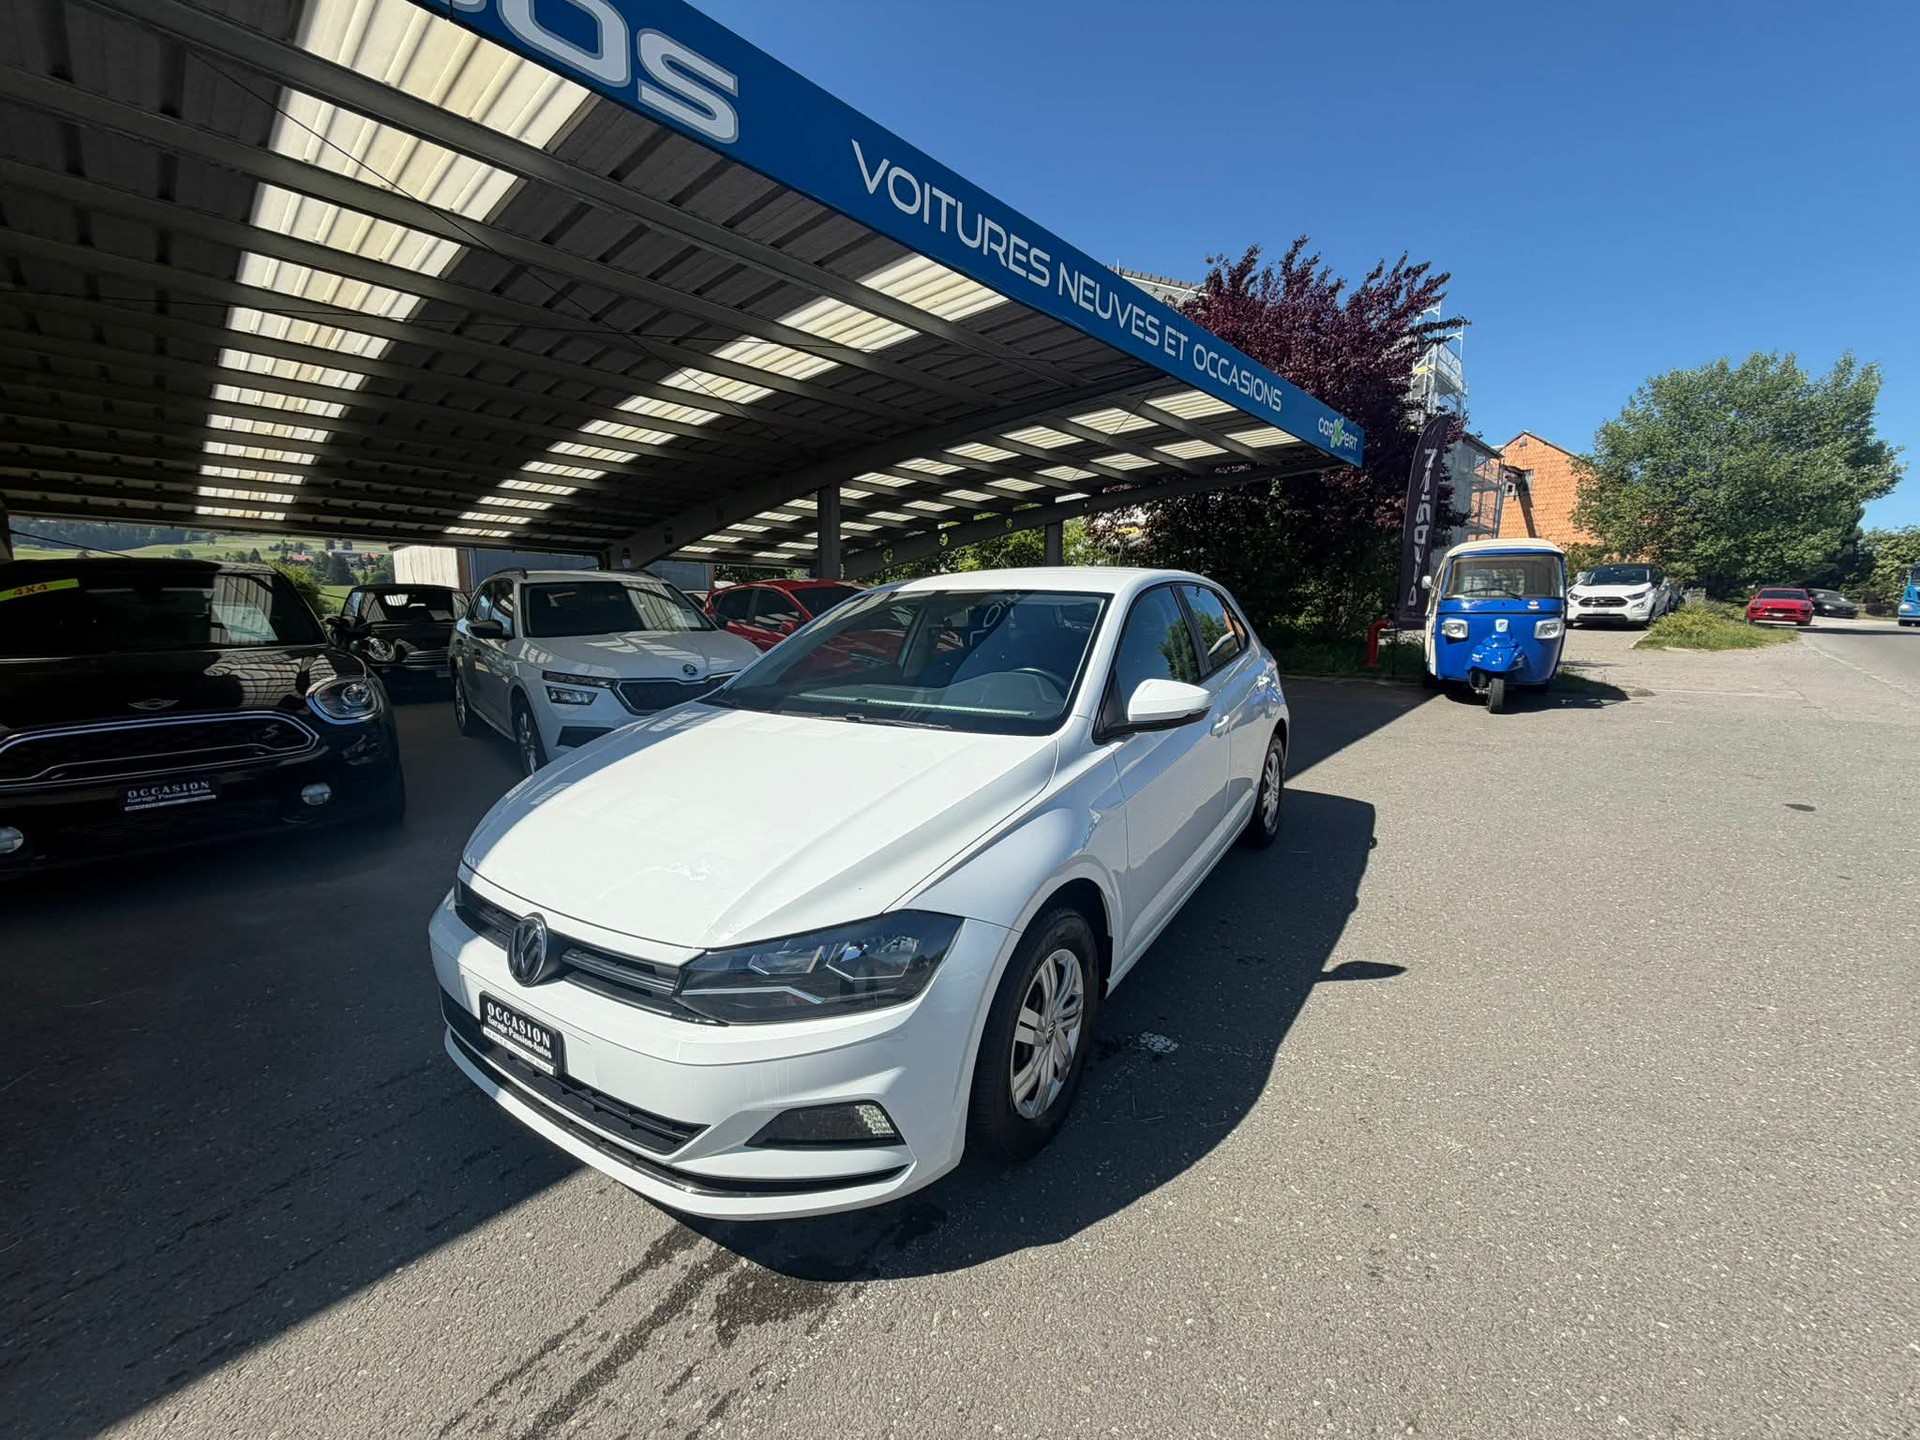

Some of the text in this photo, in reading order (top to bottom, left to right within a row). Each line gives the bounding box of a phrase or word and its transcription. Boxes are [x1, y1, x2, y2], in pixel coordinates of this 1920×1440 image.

[440, 0, 738, 144] OS
[851, 138, 1283, 413] VOITURES NEUVES ET OCCASIONS
[127, 781, 210, 798] OCCASION
[487, 1002, 551, 1048] OCCASION
[487, 1015, 508, 1034] Garage
[508, 1027, 552, 1059] Passion-Autos
